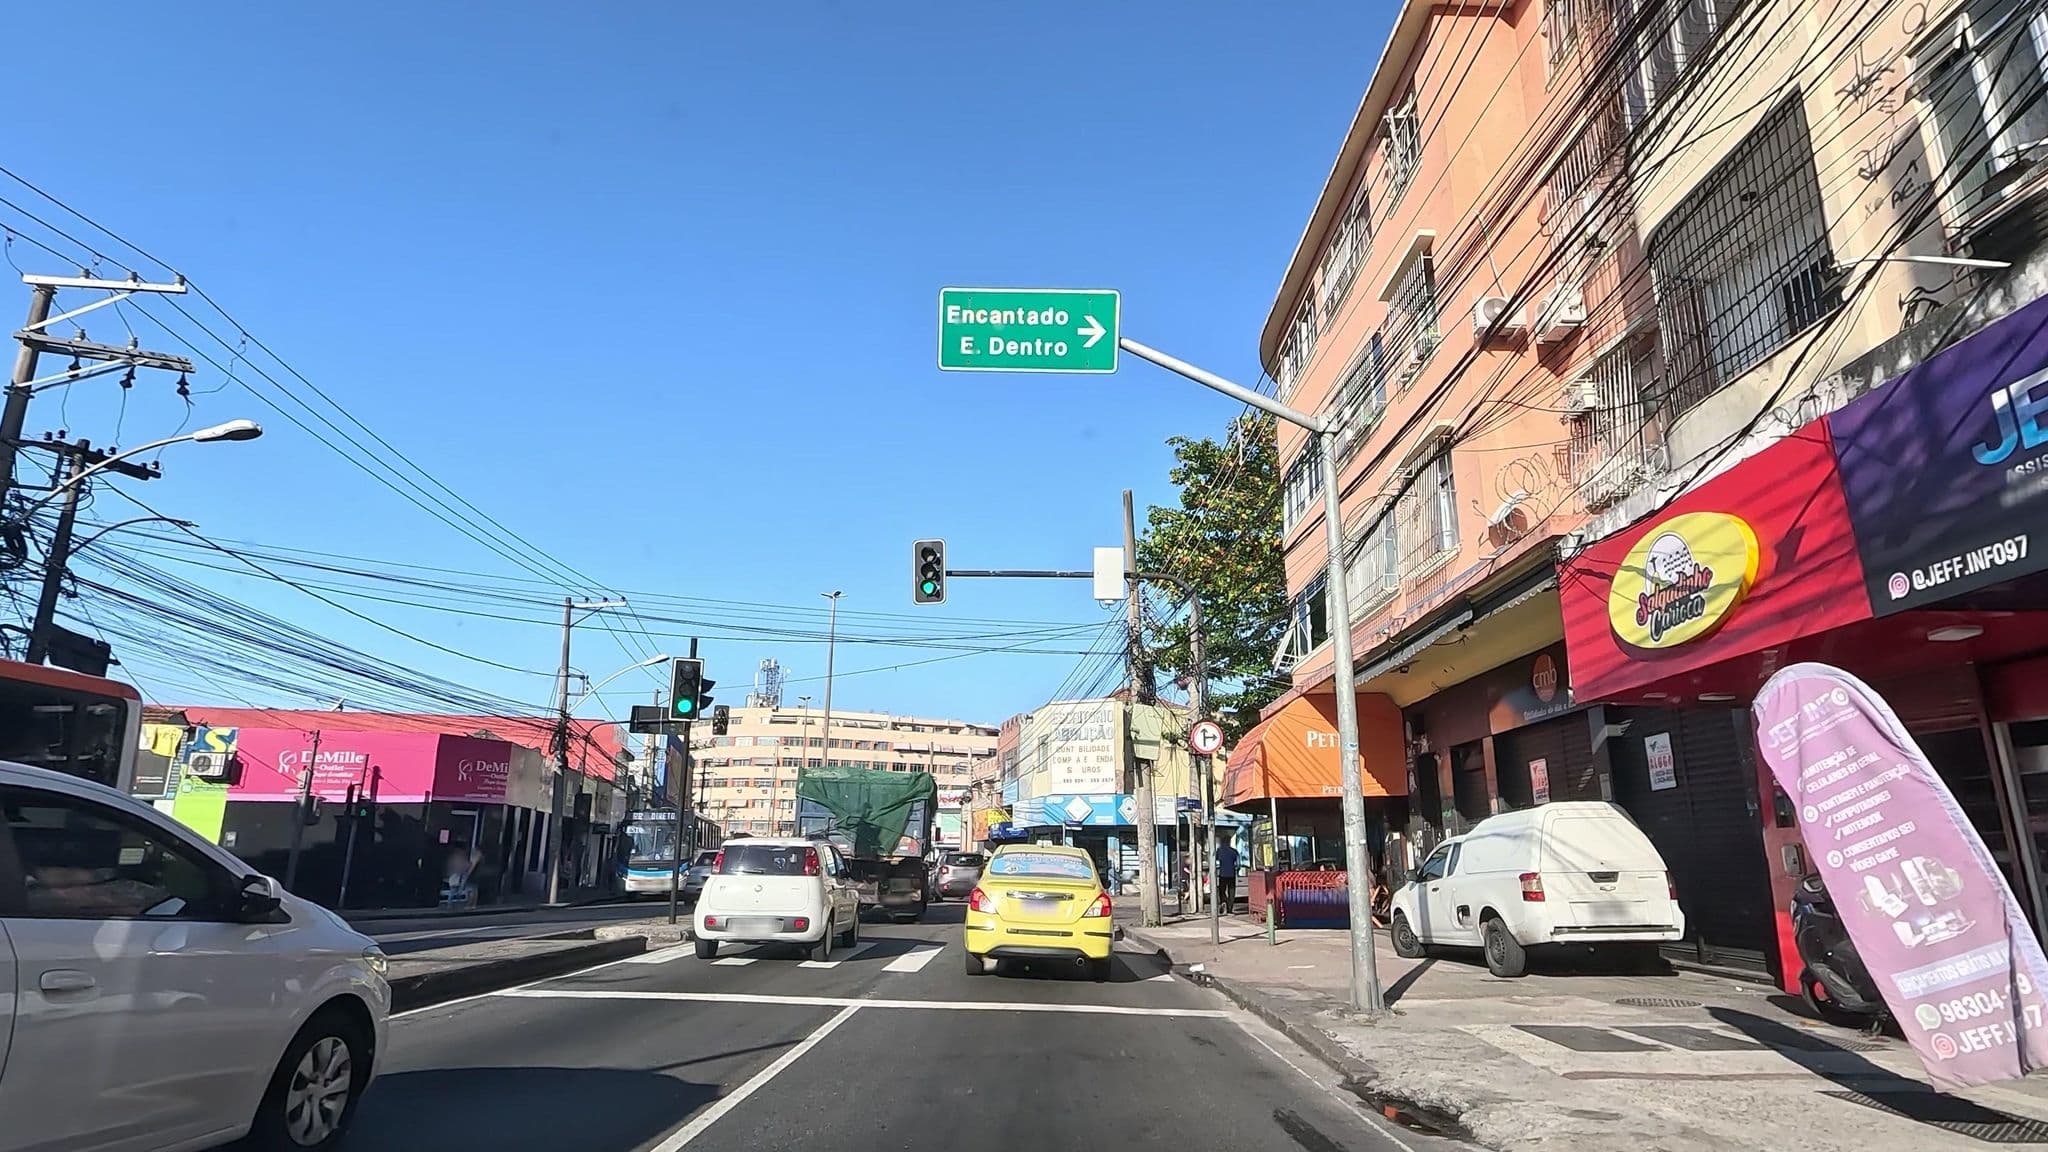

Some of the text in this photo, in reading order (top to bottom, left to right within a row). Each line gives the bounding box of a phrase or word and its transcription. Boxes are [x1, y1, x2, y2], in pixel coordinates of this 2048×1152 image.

[946, 305, 1069, 326] Encantado
[960, 336, 1068, 357] E. Dentro
[1972, 366, 2048, 465] JE
[2006, 453, 2048, 483] ASSIS
[1911, 534, 2029, 591] @JEFF.INFO97
[1636, 562, 1714, 627] Salgadinho
[1650, 594, 1706, 642] Carioca
[1532, 667, 1557, 689] cmb
[301, 751, 364, 764] DeMille
[1052, 756, 1081, 764] COMPA
[1094, 754, 1114, 763] ENDA
[1057, 744, 1111, 753] CONTBILIDADE
[476, 760, 508, 773] DeMi
[1066, 766, 1102, 774] SUROS
[1806, 766, 1850, 794] CELULARES
[1858, 751, 1882, 773] GERAL
[1322, 785, 1344, 794] PETR
[1817, 785, 1861, 813] MONTAGEM
[650, 812, 676, 820] DIRETO
[1832, 790, 1892, 823] COMPUTADORES
[1842, 811, 1884, 837] NOTEBOOK
[1843, 820, 1916, 859] CONSERTAMOS SEU
[1849, 846, 1900, 873] VÍDEO GAME
